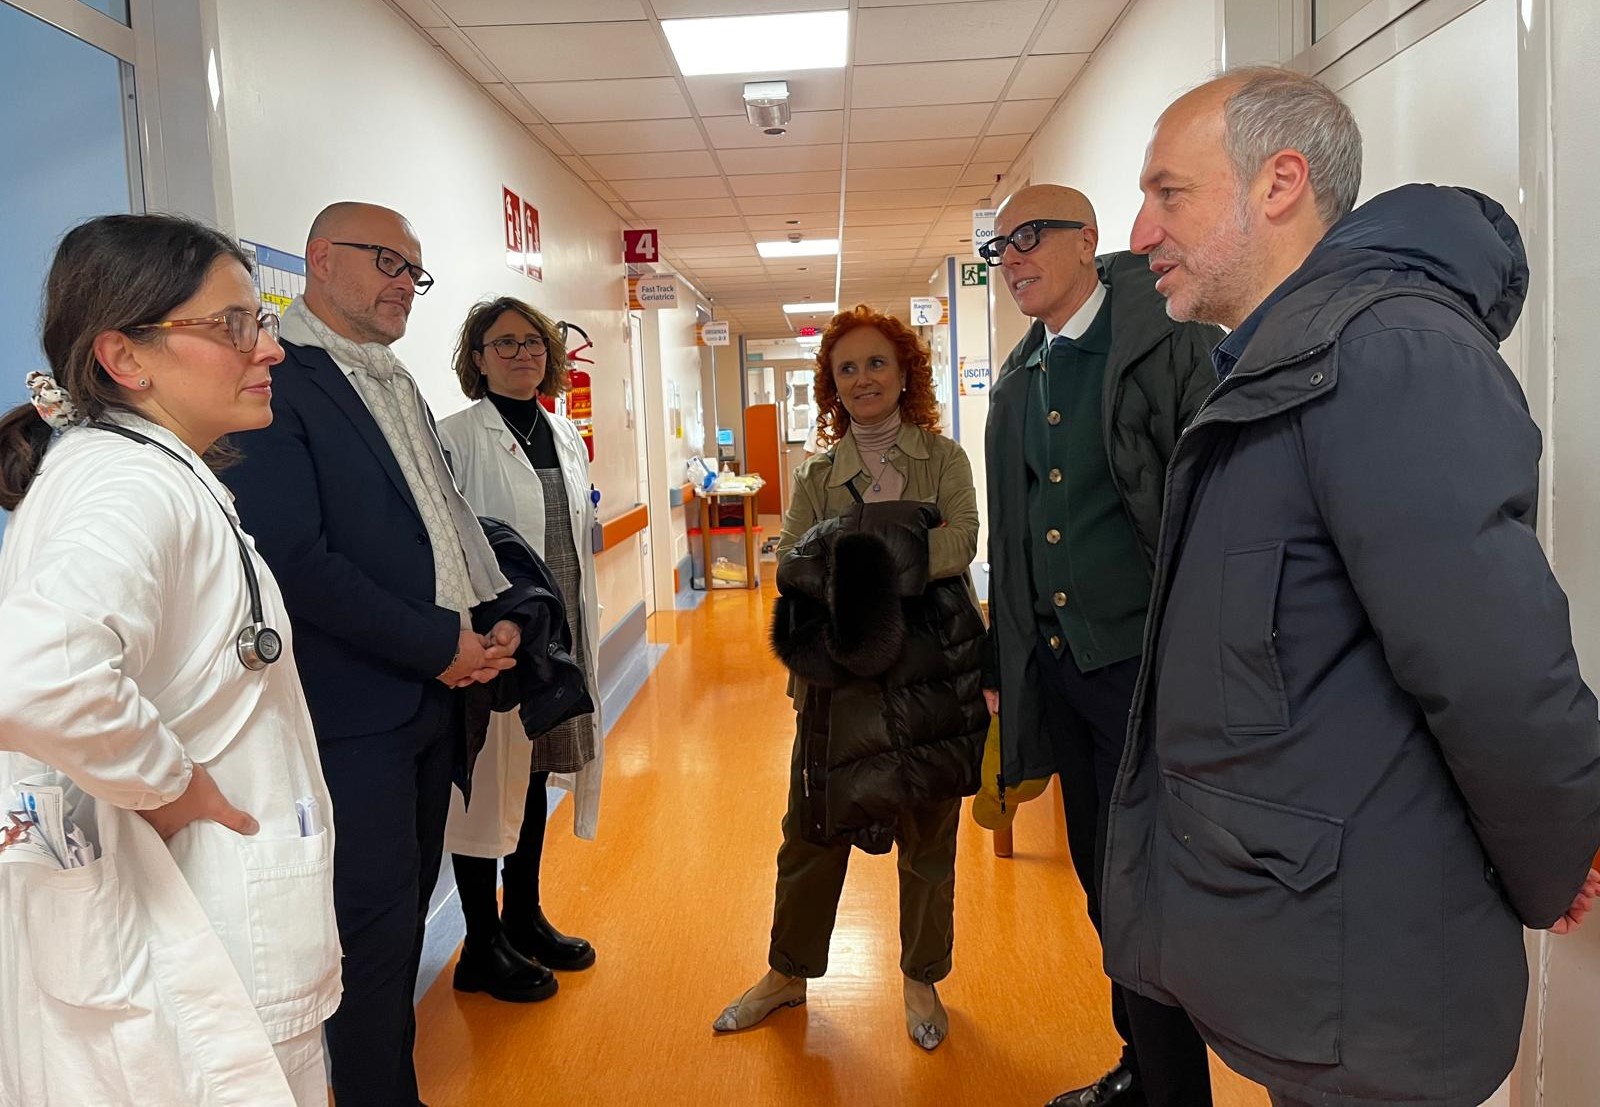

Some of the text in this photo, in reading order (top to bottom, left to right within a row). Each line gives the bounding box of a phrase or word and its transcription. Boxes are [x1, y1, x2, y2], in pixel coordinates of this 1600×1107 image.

[635, 233, 655, 259] 4
[641, 293, 675, 301] Geriatrico
[964, 368, 992, 378] USCITA
